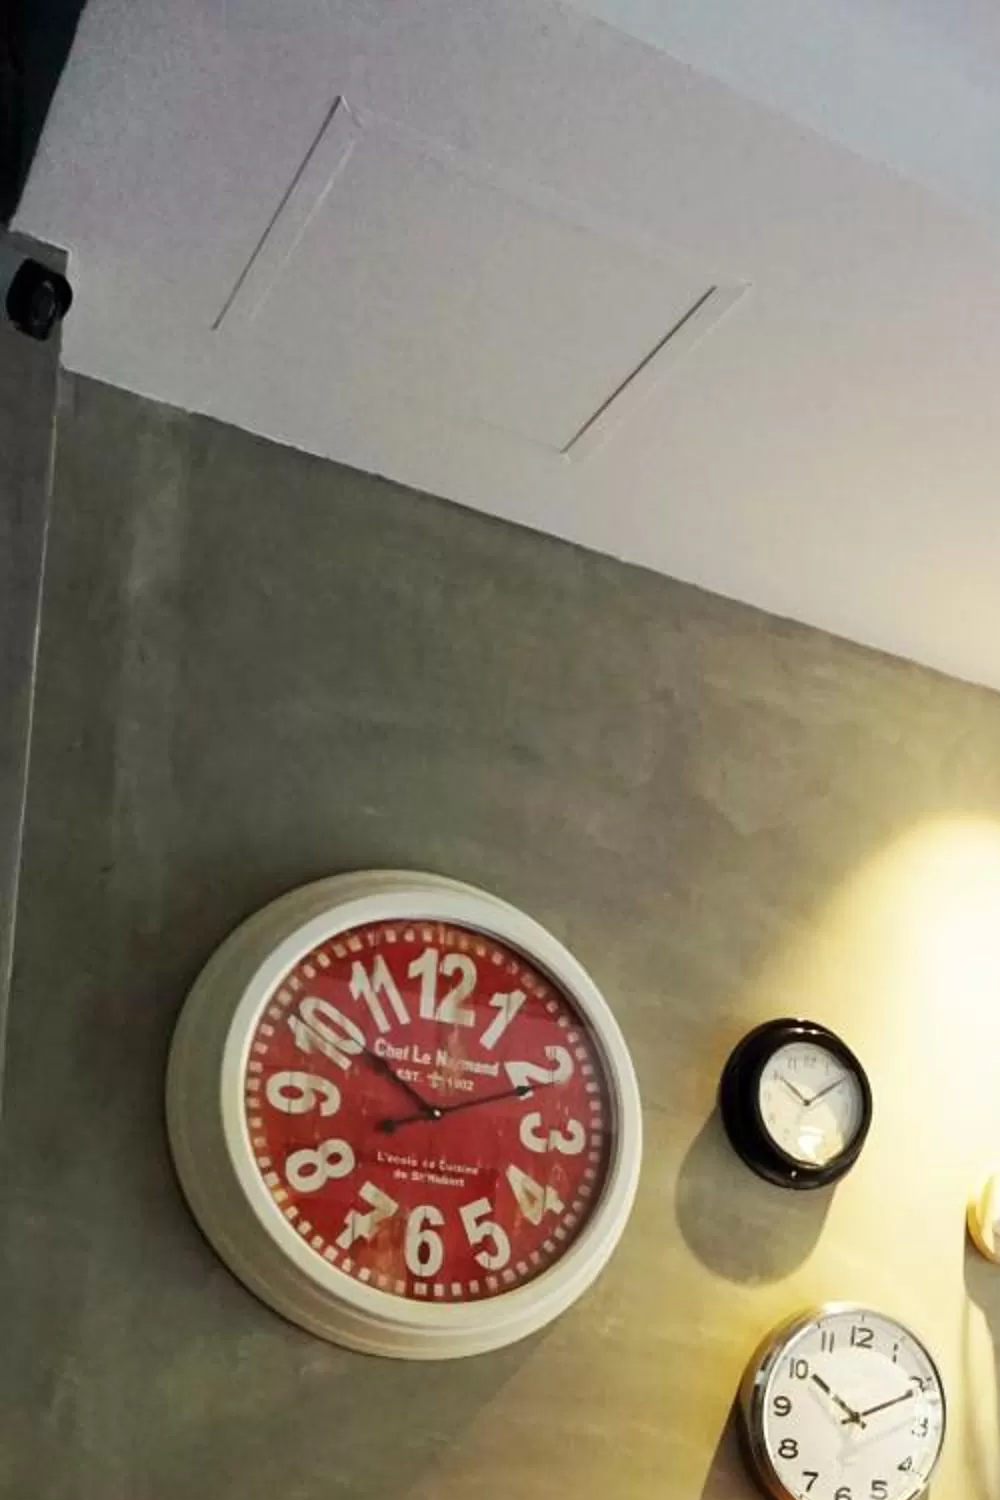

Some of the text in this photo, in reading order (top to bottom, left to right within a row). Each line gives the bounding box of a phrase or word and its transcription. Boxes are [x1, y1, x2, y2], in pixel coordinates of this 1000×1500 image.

[349, 954, 410, 1033] 11
[408, 947, 477, 1028] 12
[287, 997, 366, 1070] 10
[479, 989, 527, 1050] 1
[412, 1043, 432, 1065] Le
[505, 1044, 574, 1098] 2
[266, 1071, 341, 1117] 9
[519, 1112, 586, 1156] 3
[285, 1138, 355, 1193] 8
[336, 1181, 398, 1249] 7
[505, 1164, 564, 1225] 4
[405, 1206, 445, 1277] 6
[459, 1198, 511, 1270] 5
[821, 1330, 835, 1353] 11
[850, 1325, 875, 1349] 12
[789, 1358, 809, 1379] 10
[773, 1395, 792, 1417] 9
[778, 1438, 799, 1459] 8
[802, 1471, 819, 1493] 7
[871, 1480, 889, 1500] 5
